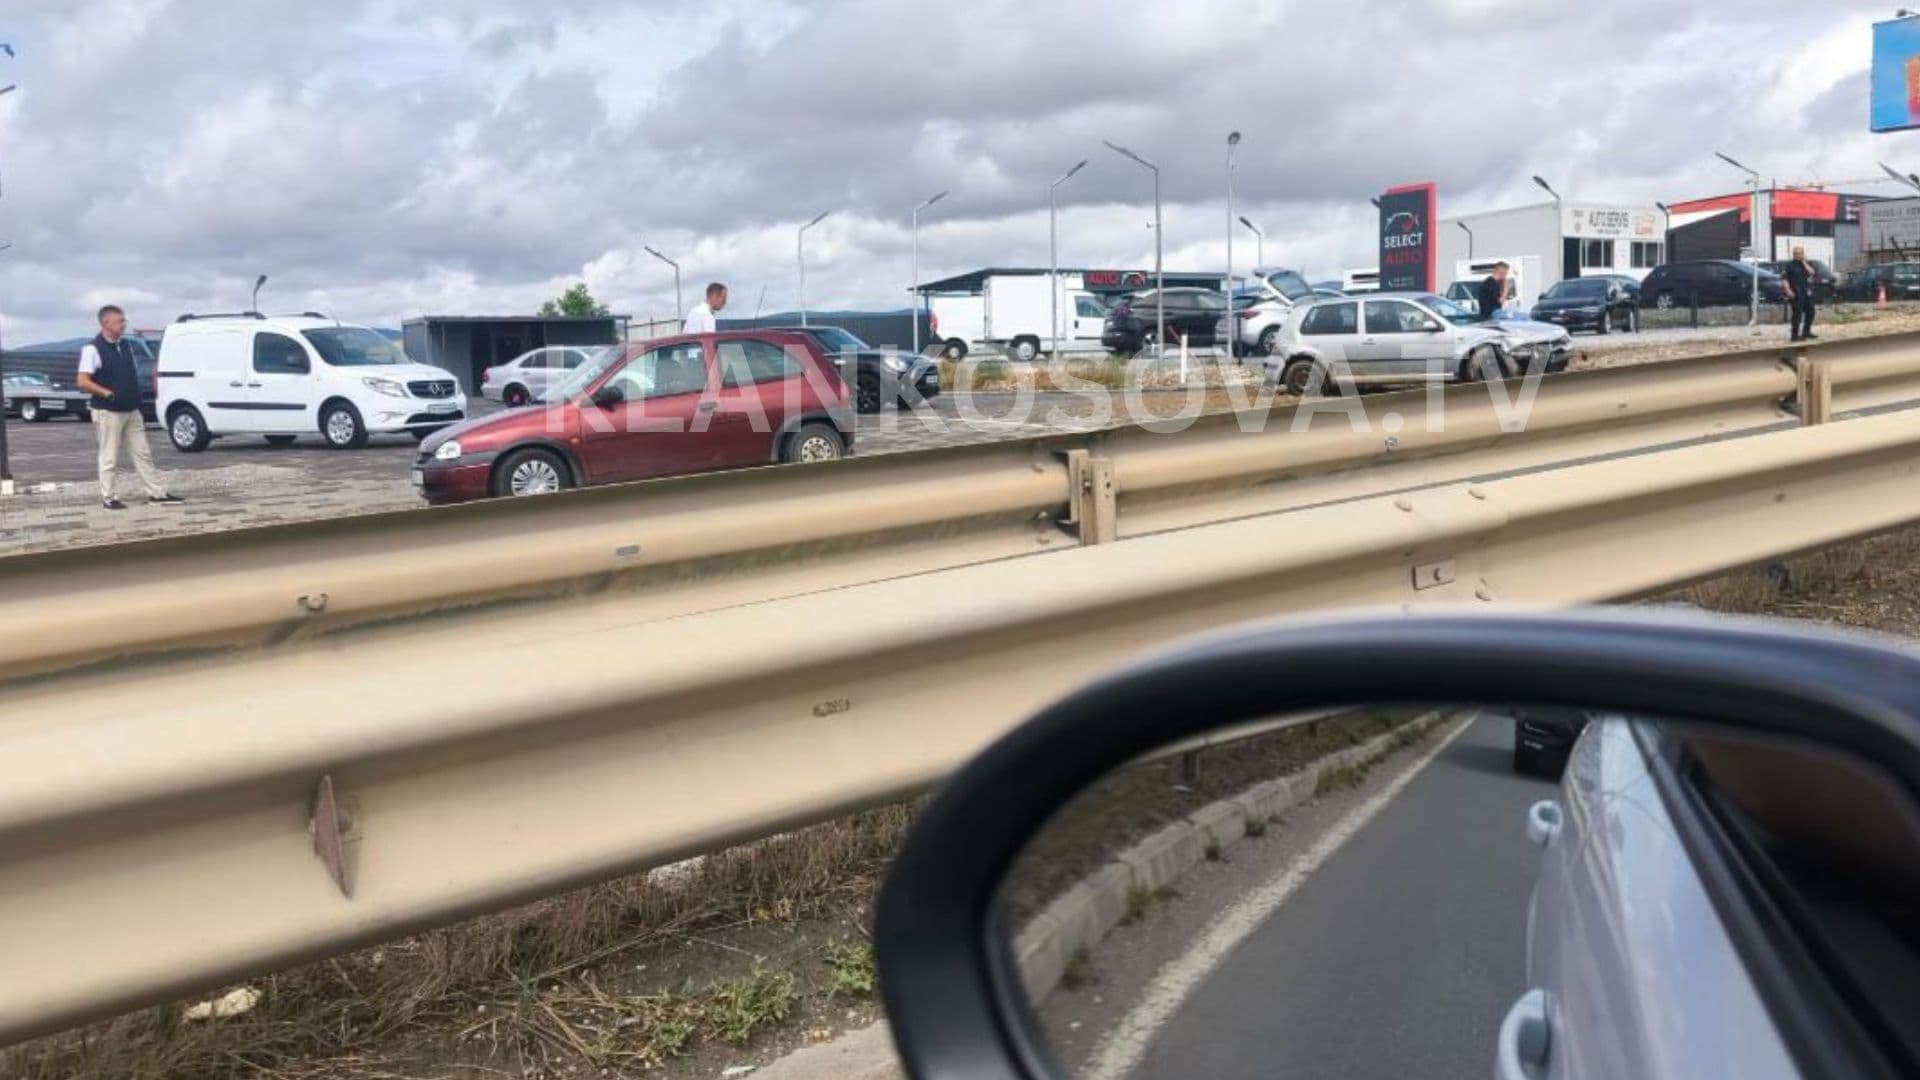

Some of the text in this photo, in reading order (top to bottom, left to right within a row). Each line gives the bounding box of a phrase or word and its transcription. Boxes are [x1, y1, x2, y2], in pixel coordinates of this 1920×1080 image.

[1384, 232, 1424, 248] SELECT
[1385, 249, 1423, 265] AUTO
[1088, 272, 1118, 285] AUTO
